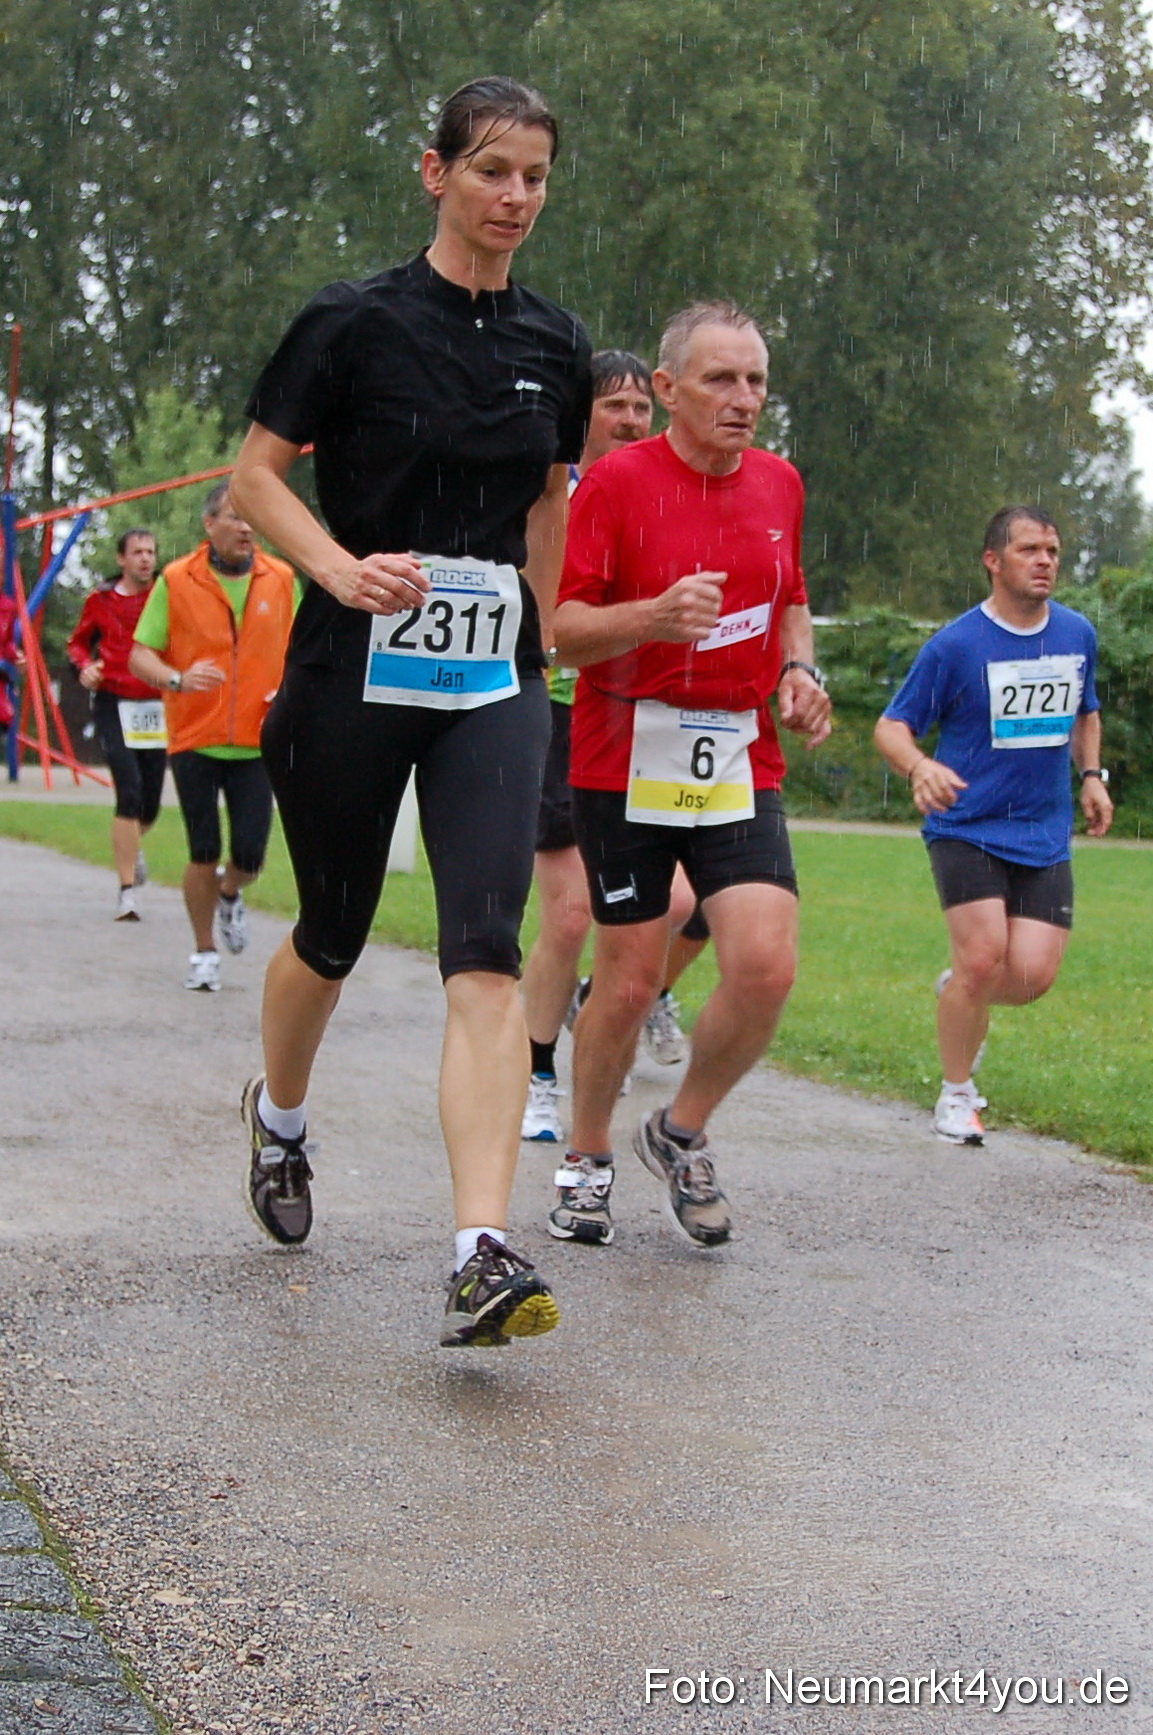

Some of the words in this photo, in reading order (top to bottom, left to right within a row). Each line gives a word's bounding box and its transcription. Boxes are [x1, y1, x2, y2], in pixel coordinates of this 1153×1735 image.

[388, 599, 507, 654] 2311
[430, 666, 464, 688] Jan
[1002, 683, 1071, 715] 2727
[690, 736, 716, 781] 6
[674, 790, 709, 809] Jos
